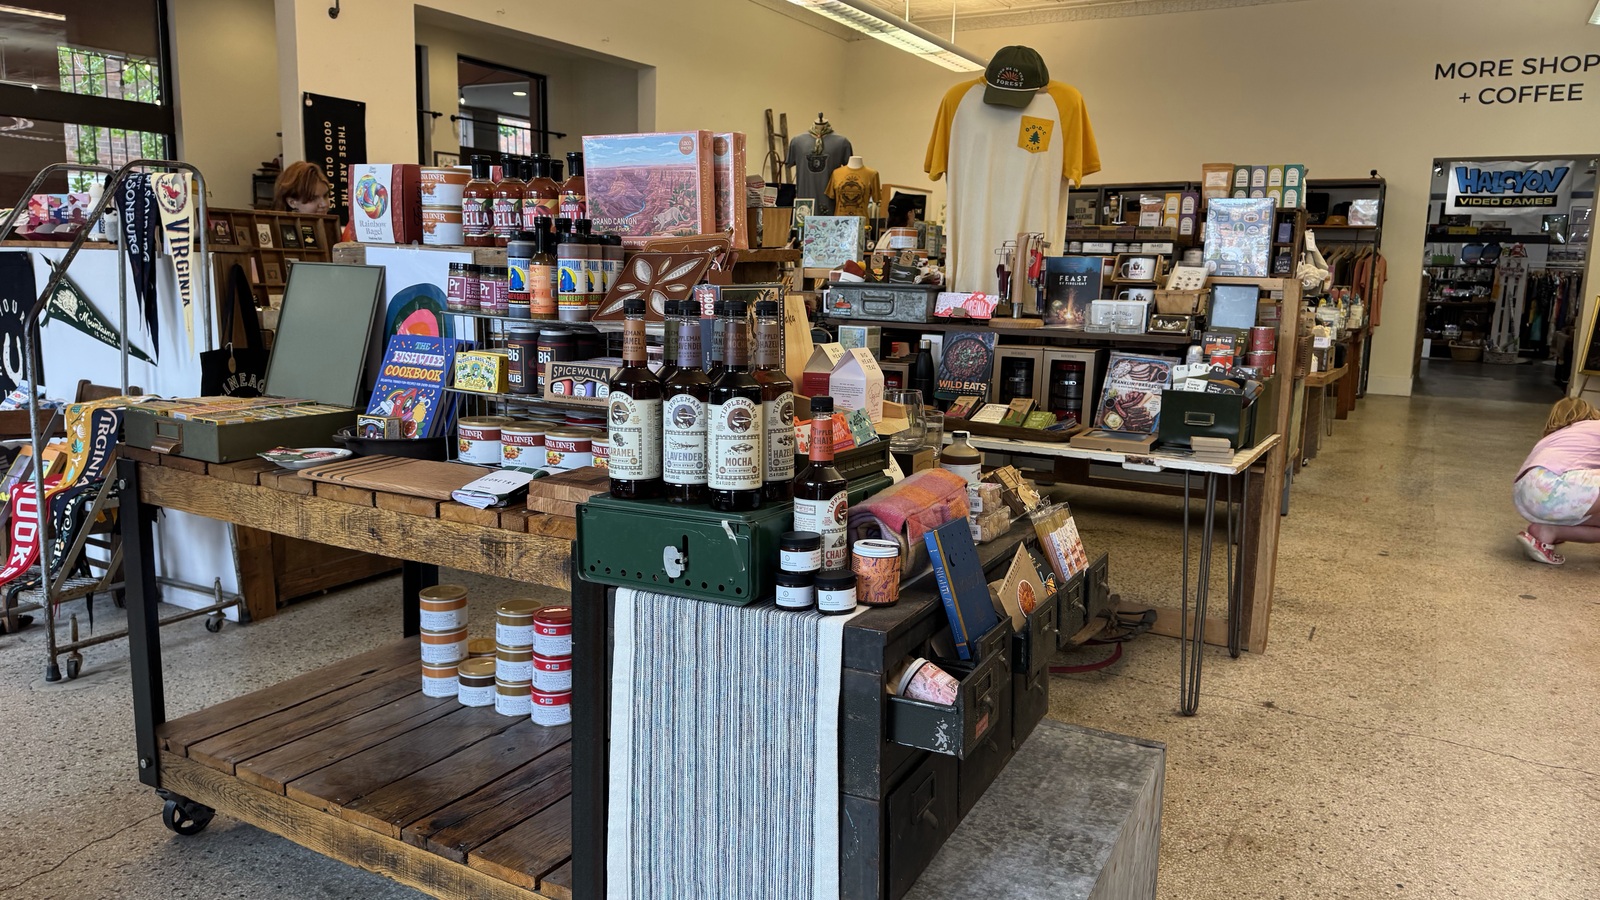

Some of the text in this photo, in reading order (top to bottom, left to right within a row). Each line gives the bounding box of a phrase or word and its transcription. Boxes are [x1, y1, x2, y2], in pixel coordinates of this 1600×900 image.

[1434, 54, 1600, 80] MORE SHOP
[996, 79, 1024, 87] FOREST
[1478, 83, 1585, 105] COFFEE
[324, 121, 333, 151] GOOD
[326, 156, 334, 179] OLD
[338, 126, 349, 207] THESE ARE THE
[428, 174, 446, 183] DINER
[1455, 166, 1570, 194] HALCYON
[1459, 196, 1553, 206] VIDEO GAMES
[429, 213, 447, 222] DINER
[592, 217, 637, 226] GRAND CANYON
[365, 228, 383, 237] Bagel
[165, 216, 190, 307] VIRGINIA
[449, 279, 460, 291] Pr
[703, 293, 715, 316] 1000
[78, 311, 117, 341] Mountains
[415, 341, 431, 350] THE
[391, 350, 445, 367] FISHWIFE
[384, 364, 444, 382] COOKBOOK
[553, 366, 607, 382] SPICEWALLA
[221, 372, 266, 396] INEAG
[938, 379, 987, 391] WILD EATS
[720, 399, 758, 419] TIPPLEMAN'S
[464, 430, 484, 440] DINER
[513, 435, 535, 446] DINER
[75, 409, 118, 488] VIRGINIA
[556, 440, 577, 453] DINER
[666, 452, 703, 461] LAVENDER
[725, 457, 753, 467] MOCHA
[825, 550, 839, 560] CHAI
